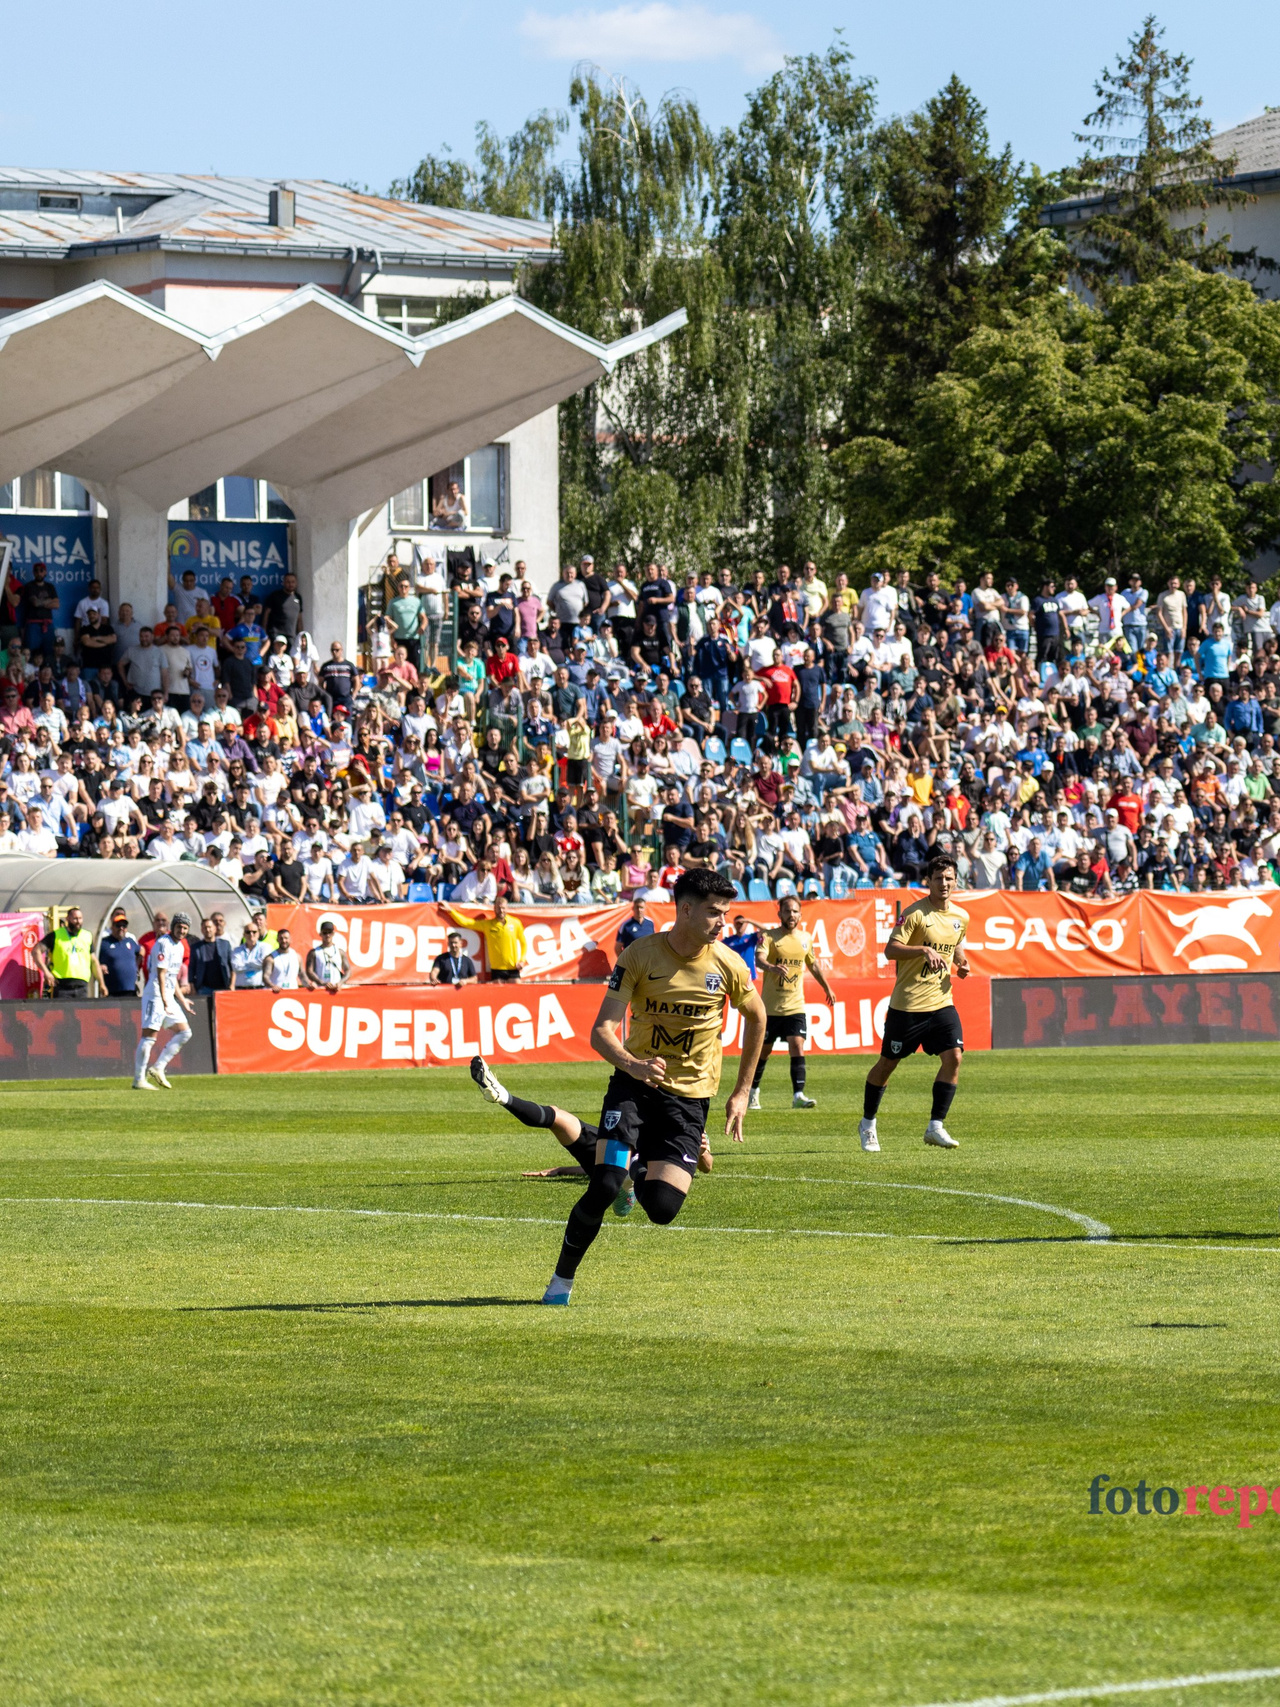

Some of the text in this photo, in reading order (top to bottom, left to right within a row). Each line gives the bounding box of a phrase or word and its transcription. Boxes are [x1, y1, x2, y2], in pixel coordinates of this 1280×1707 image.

[267, 993, 576, 1060] SUPERLIGA
[644, 997, 713, 1018] MAXBET
[1021, 982, 1278, 1045] PLAYER
